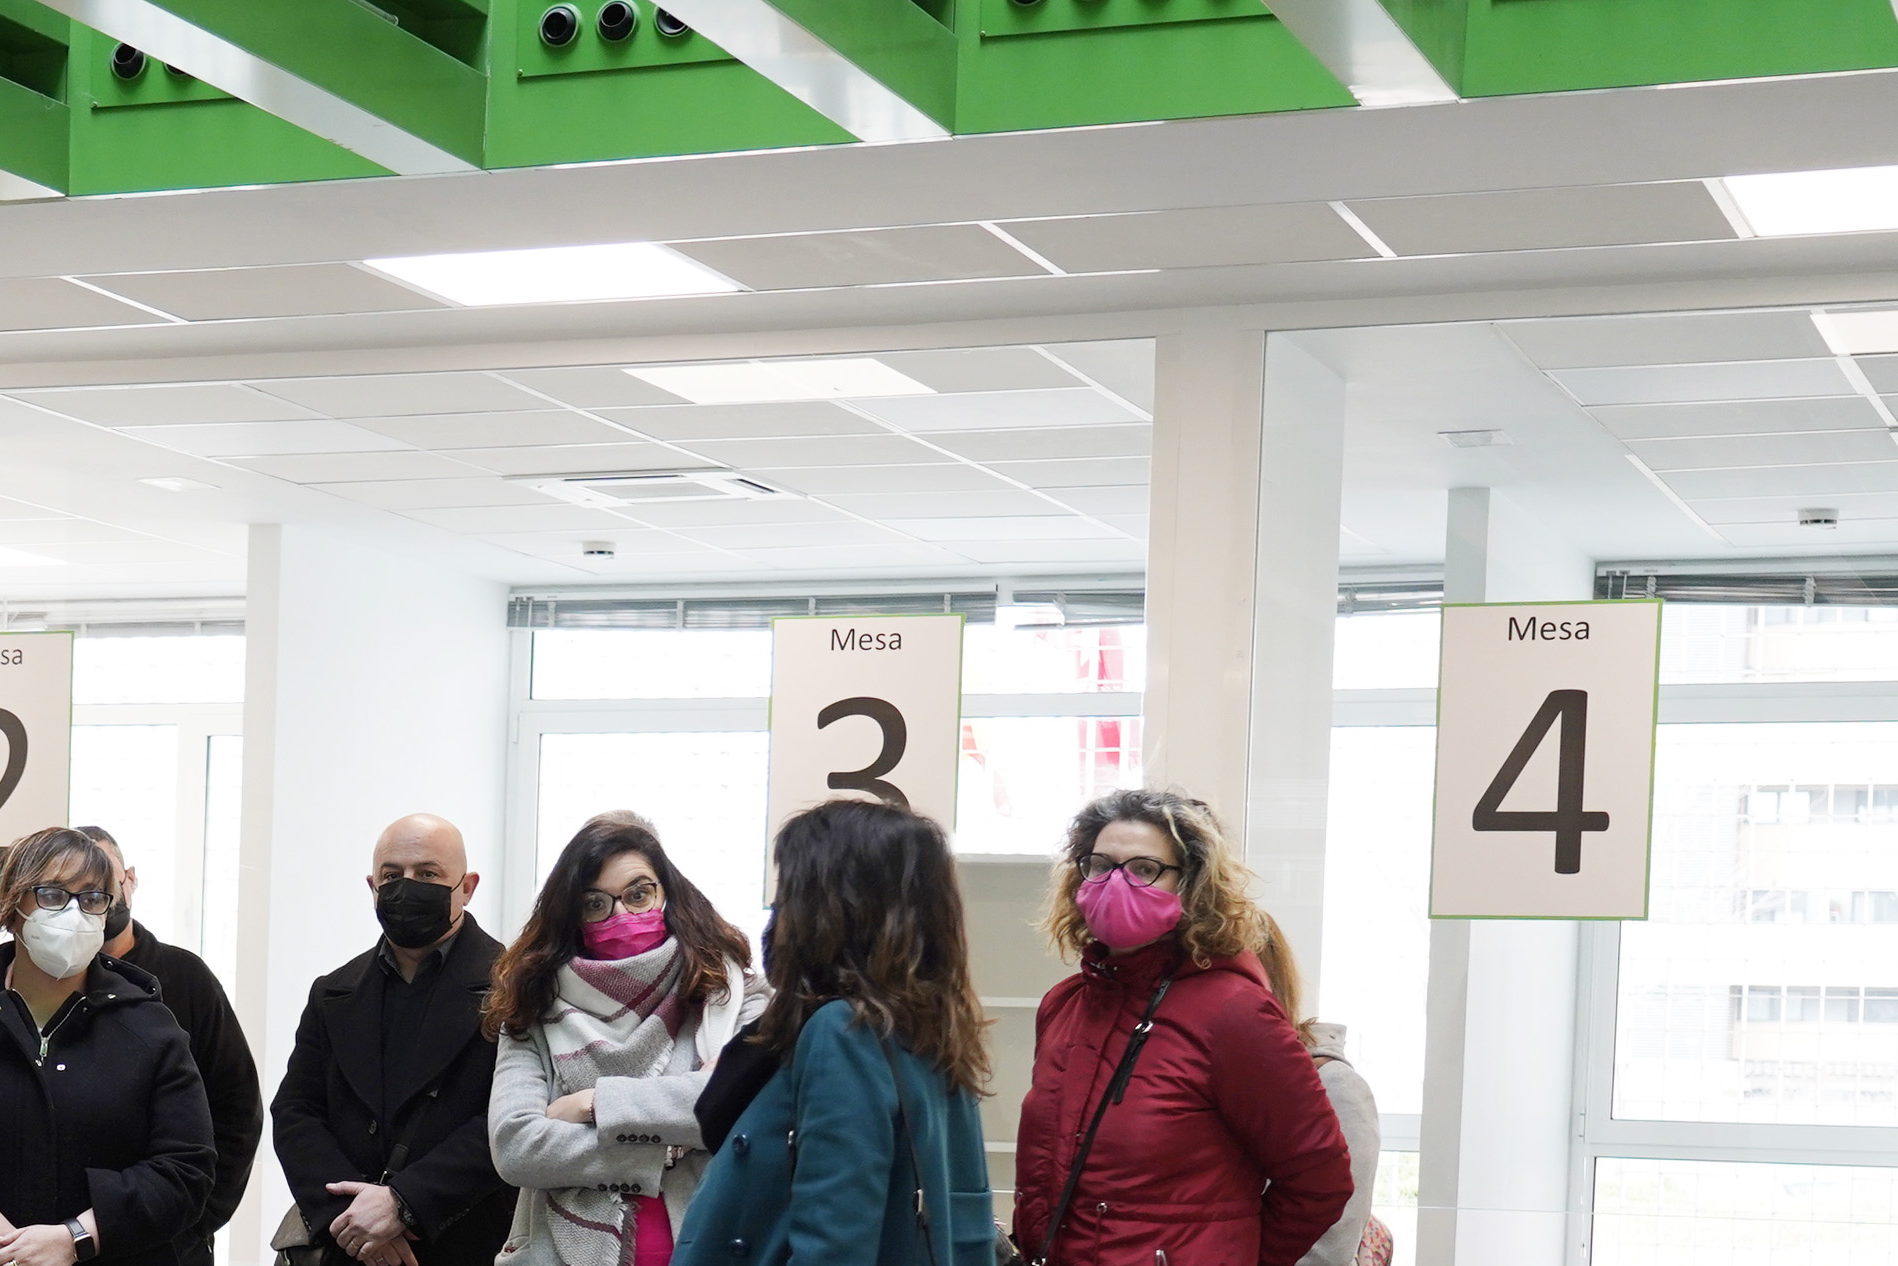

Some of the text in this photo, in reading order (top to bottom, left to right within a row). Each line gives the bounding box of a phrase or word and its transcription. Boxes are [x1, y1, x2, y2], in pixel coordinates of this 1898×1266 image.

[830, 628, 902, 651] Mesa
[1507, 616, 1590, 641] Mesa
[817, 696, 912, 812] 3
[1471, 688, 1610, 875] 4
